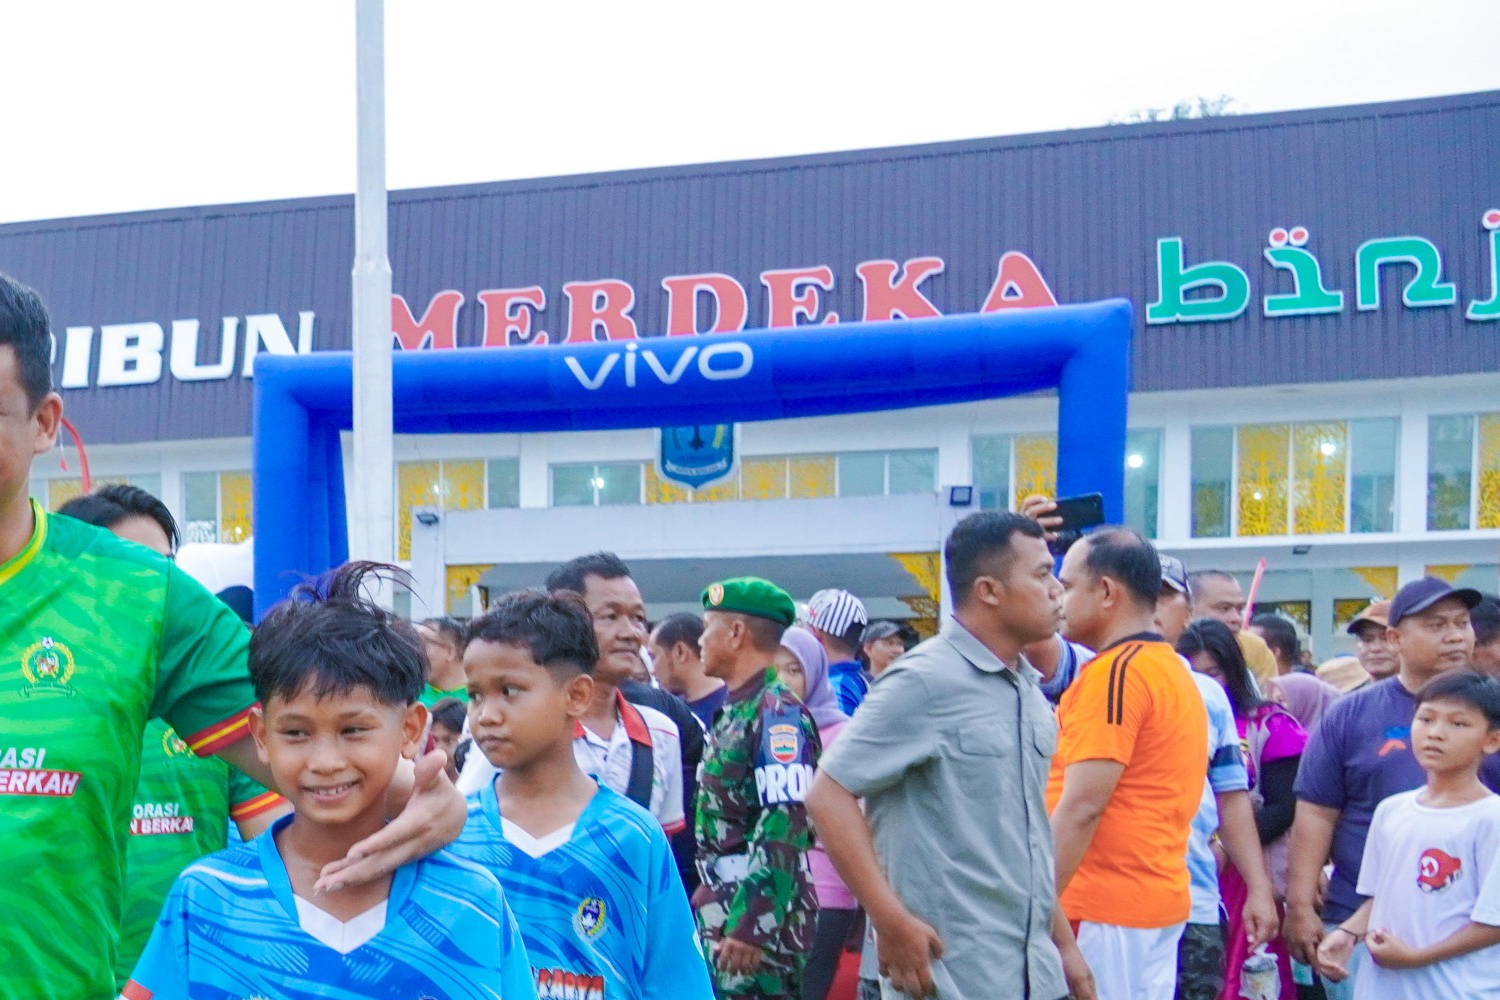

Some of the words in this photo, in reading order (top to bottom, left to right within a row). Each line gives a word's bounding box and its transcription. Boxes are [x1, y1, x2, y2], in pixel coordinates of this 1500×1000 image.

[51, 311, 316, 389] IBUN
[391, 251, 1059, 351] MERDEKA
[564, 341, 754, 391] vivo
[133, 802, 180, 818] ORASI
